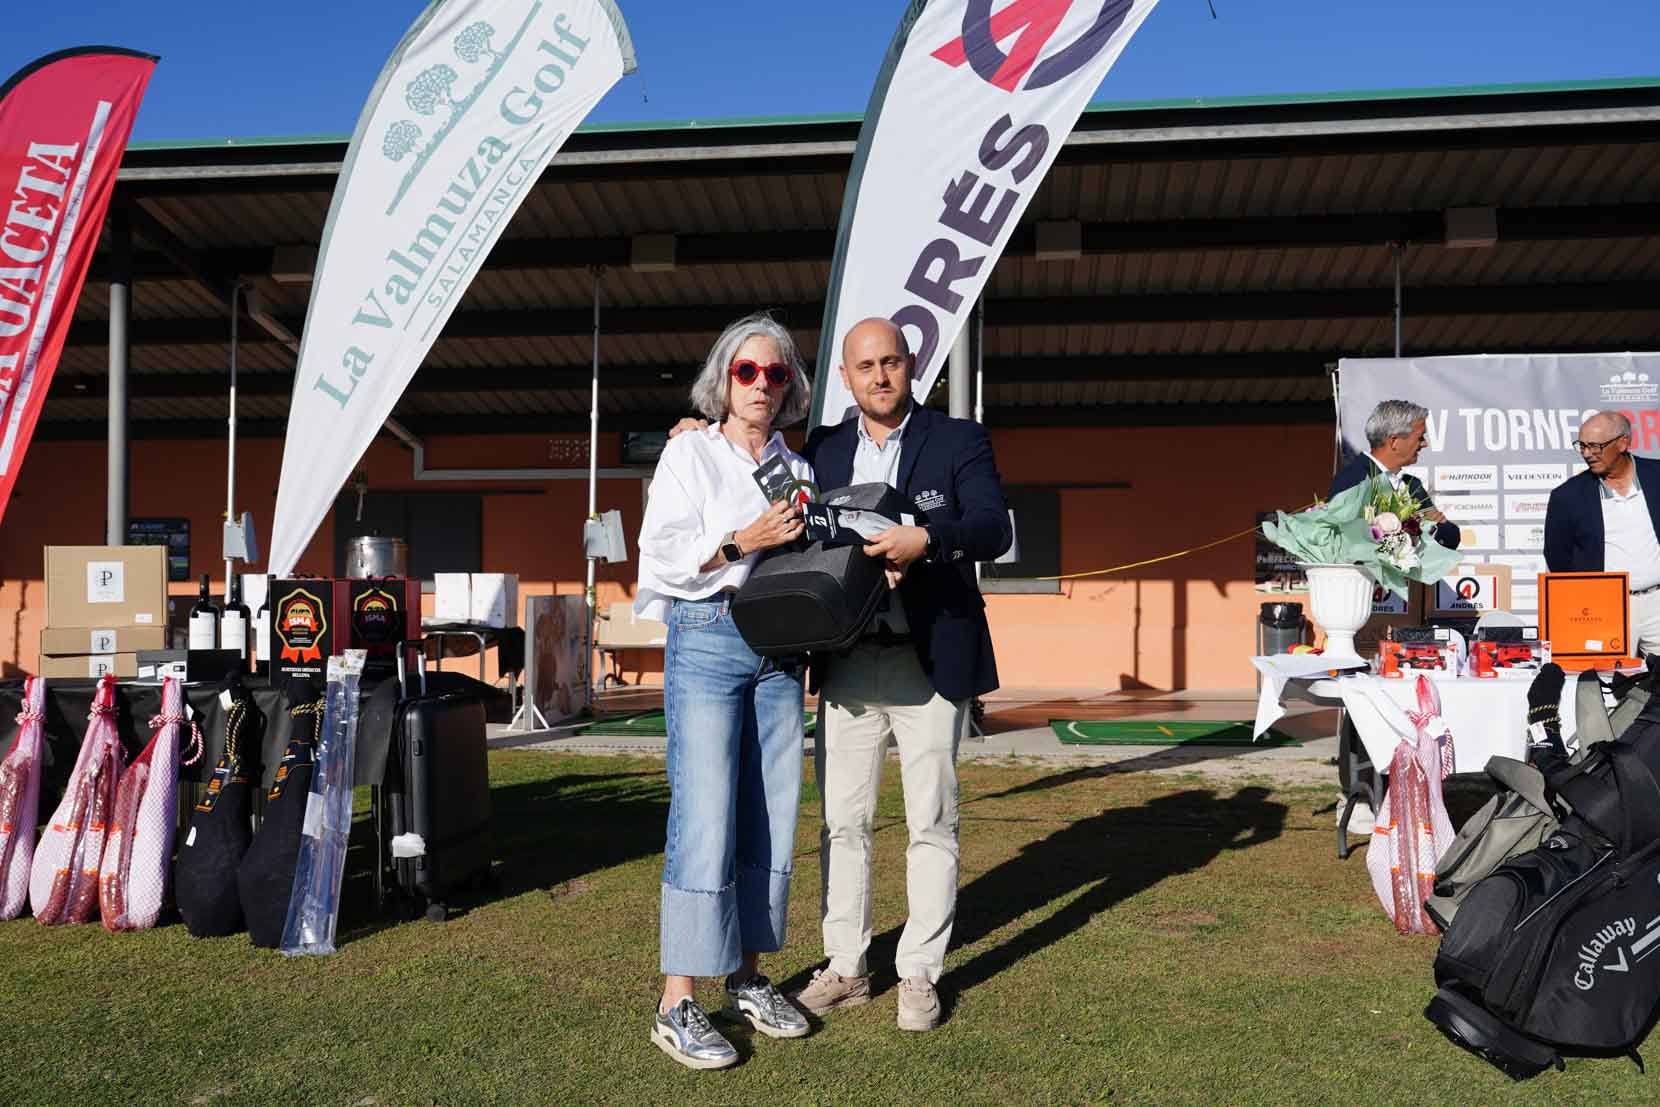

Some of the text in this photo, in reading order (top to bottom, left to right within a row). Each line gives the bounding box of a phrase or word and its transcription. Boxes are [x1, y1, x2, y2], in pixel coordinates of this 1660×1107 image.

[313, 12, 591, 410] La Valmuza Golf
[427, 157, 536, 308] SALAMANCA
[888, 113, 1050, 383] DRÉS
[1458, 407, 1600, 452] TORNE
[288, 617, 311, 627] ISMA
[1574, 916, 1636, 991] Callaway
